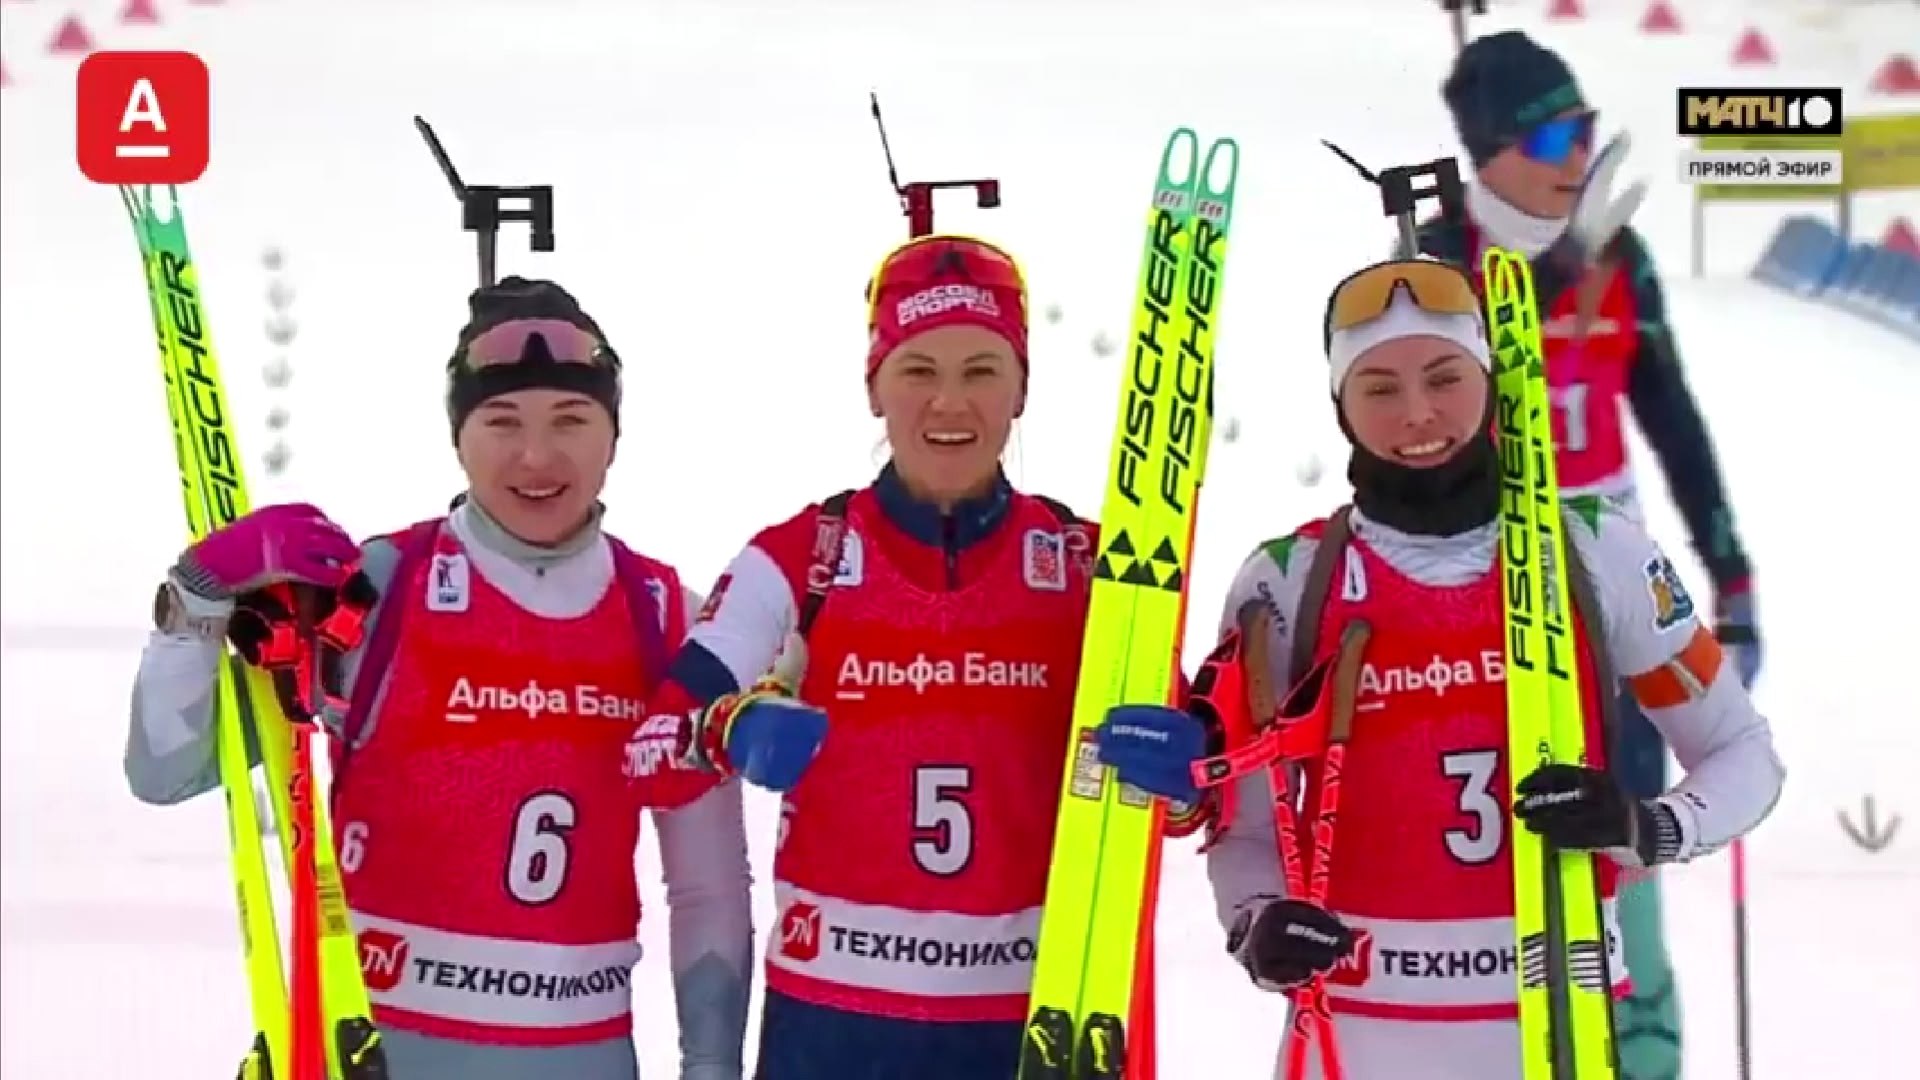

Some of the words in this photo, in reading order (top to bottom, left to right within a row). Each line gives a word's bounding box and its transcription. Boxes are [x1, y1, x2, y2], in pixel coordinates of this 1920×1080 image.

[1117, 208, 1183, 508] FISCHER
[1161, 218, 1224, 515] FISCHER
[1502, 393, 1534, 671] FISCHER
[446, 676, 569, 722] Альфа
[836, 652, 955, 698] Альфа
[963, 652, 1048, 688] Банк
[1357, 654, 1476, 708] Альфа
[341, 819, 370, 874] 6
[504, 789, 578, 907] 6
[911, 763, 974, 879] 5
[1440, 748, 1504, 868] 3
[828, 925, 1038, 968] ТЕХНОНИКО
